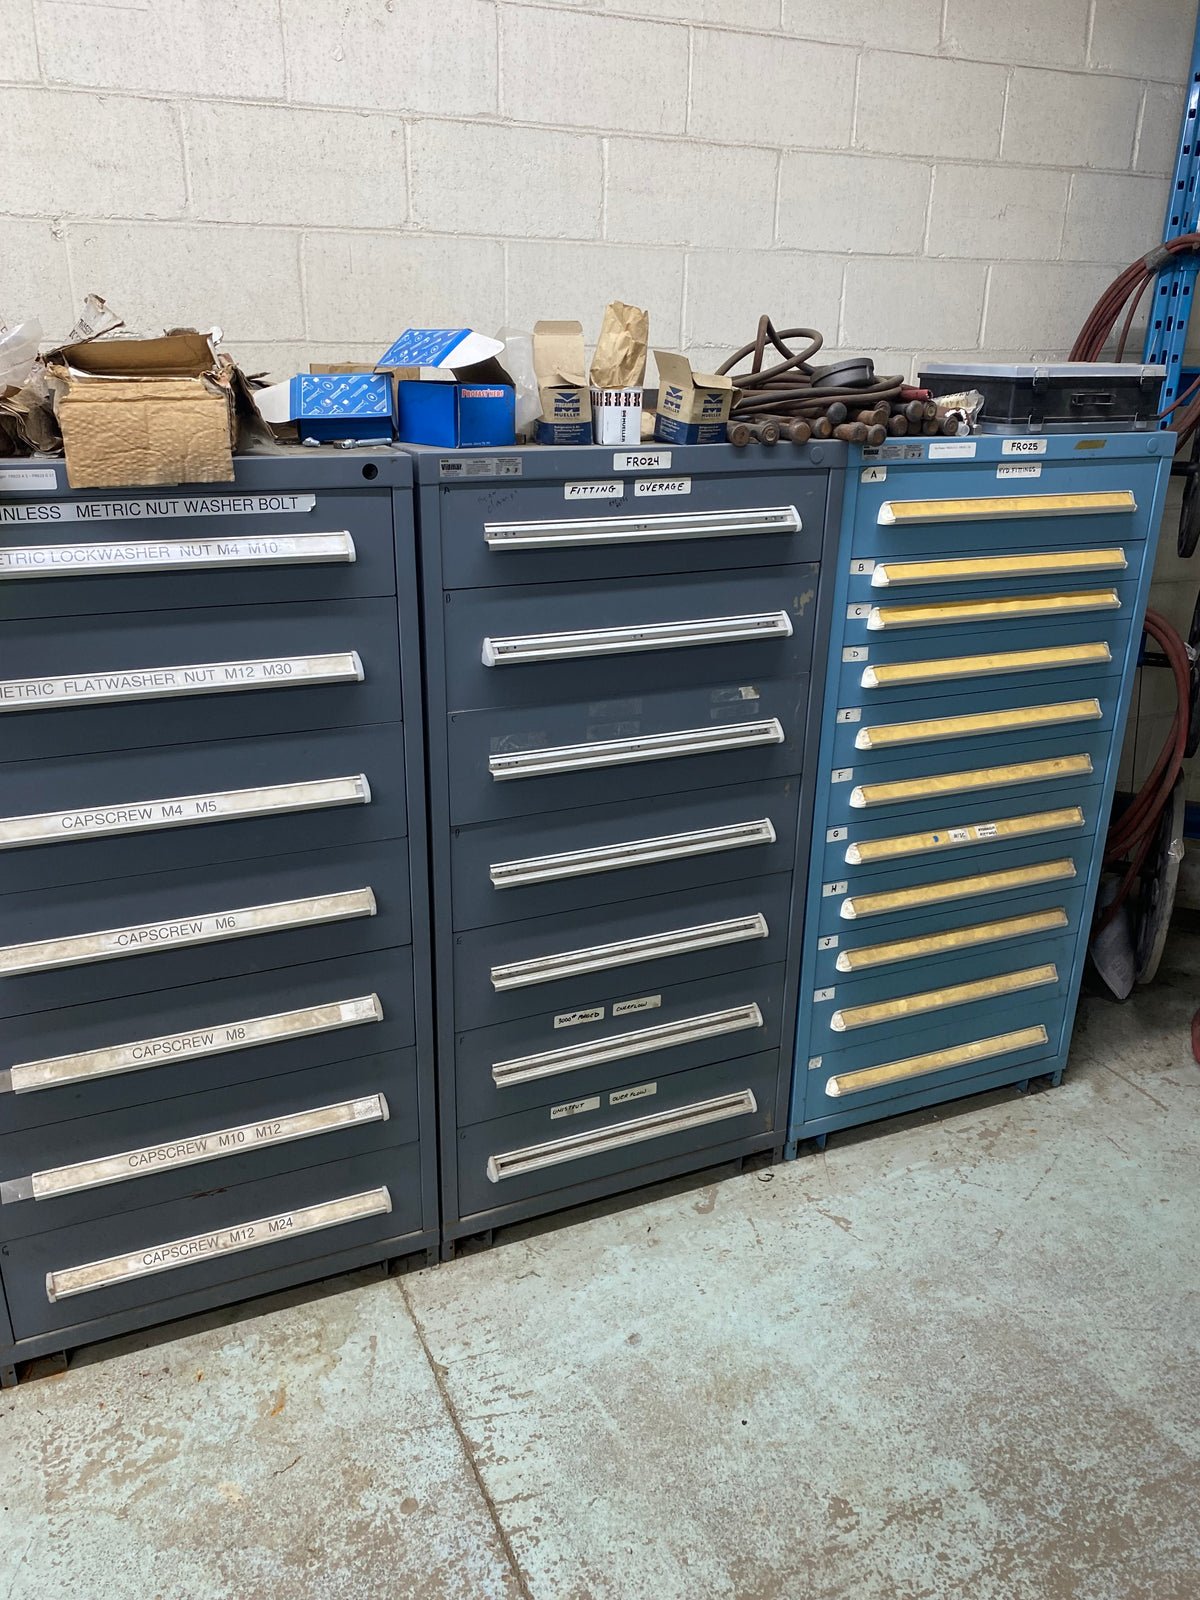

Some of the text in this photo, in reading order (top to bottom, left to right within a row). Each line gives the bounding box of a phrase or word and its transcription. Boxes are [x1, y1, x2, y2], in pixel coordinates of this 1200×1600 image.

[1010, 442, 1038, 451] FR025
[626, 457, 660, 466] FR024
[870, 470, 877, 479] A
[569, 482, 685, 495] FITTING OVERAGE
[76, 503, 141, 518] METRIC
[146, 501, 178, 515] NUT
[186, 499, 254, 513] WASHER
[258, 497, 298, 510] BOLT
[50, 546, 170, 563] LOCKWASHER
[179, 544, 211, 557] NUT
[217, 543, 240, 556] M4
[248, 541, 279, 555] M10
[858, 563, 864, 572] B
[855, 607, 861, 616] C
[852, 650, 859, 658] D
[64, 673, 176, 694] FLATWASHER
[185, 669, 215, 683] NUT
[224, 666, 255, 680] M12
[263, 662, 293, 676] M30
[845, 711, 851, 720] E
[838, 772, 844, 780] F
[61, 801, 217, 829] CAPSCREW M4 M5
[832, 829, 839, 838] G
[831, 884, 838, 893] H
[117, 915, 236, 947] CAPSCREW M6
[824, 938, 831, 946] J
[821, 990, 828, 998] K
[132, 1027, 246, 1060] CAPSCREW M8
[552, 1102, 585, 1115] UNISTRUT
[128, 1123, 282, 1168] CAPSCREW M10 M12
[142, 1217, 294, 1266] CAPSCREW M12 M24
